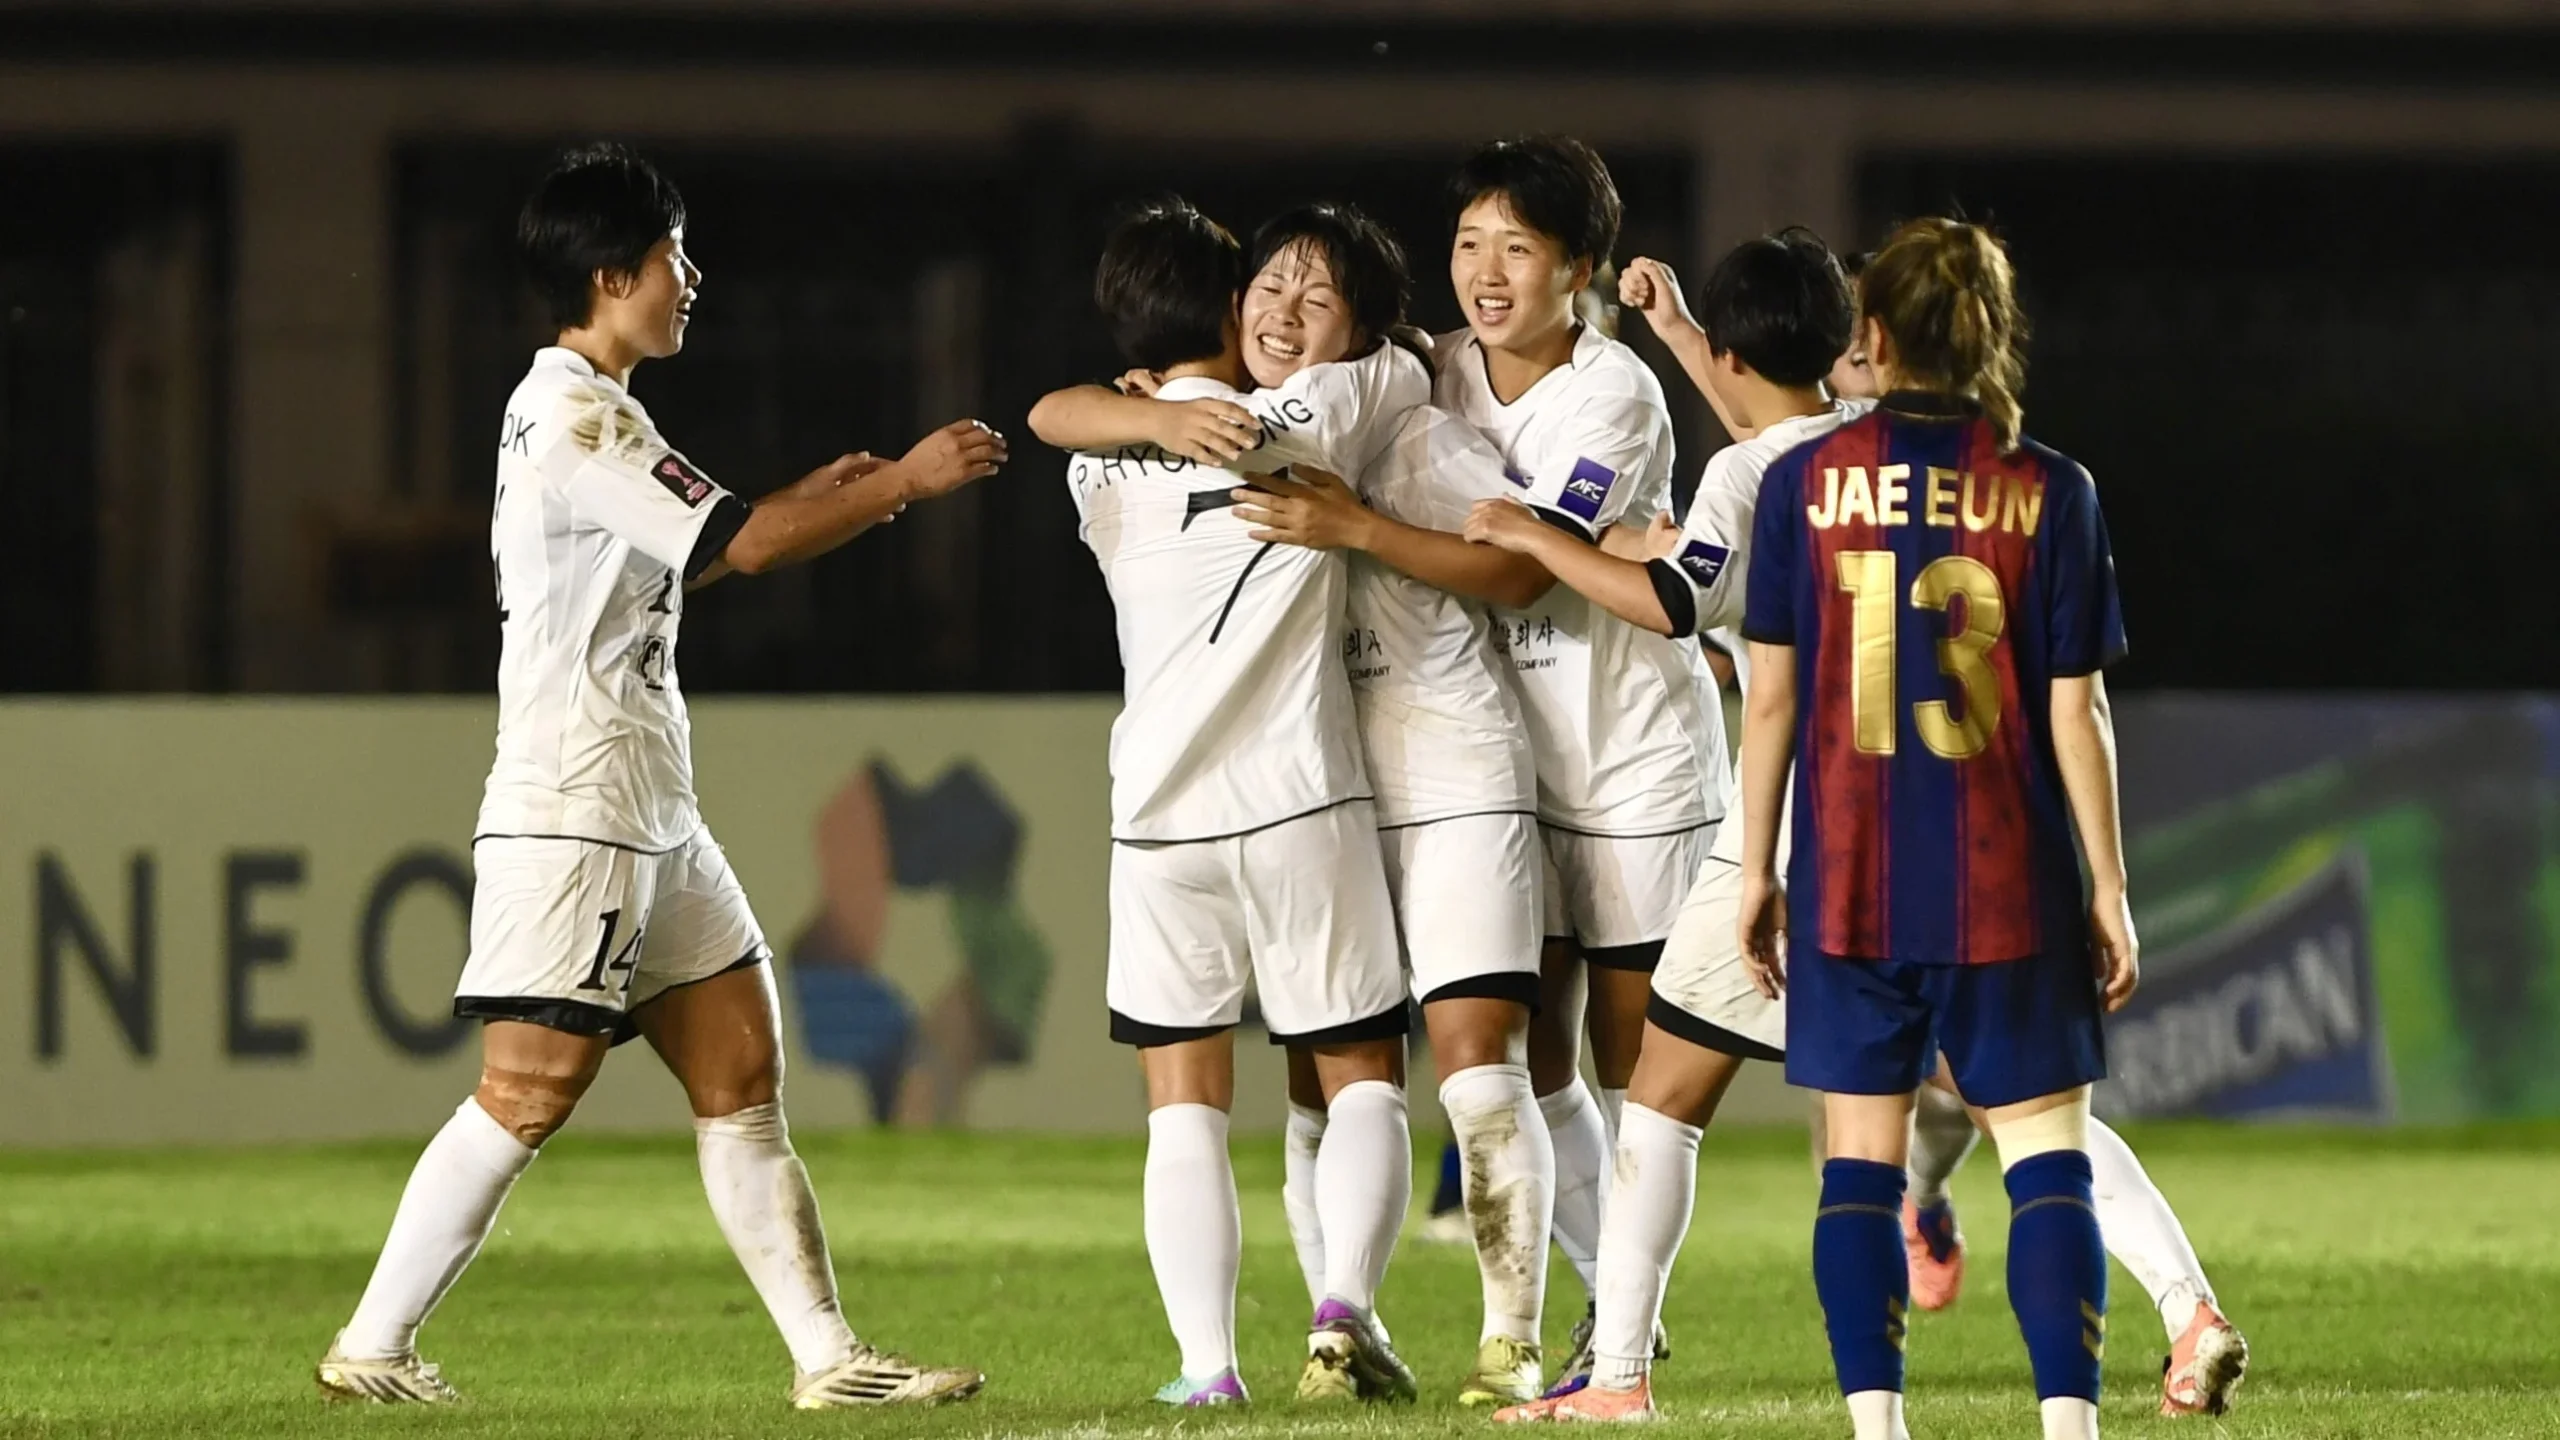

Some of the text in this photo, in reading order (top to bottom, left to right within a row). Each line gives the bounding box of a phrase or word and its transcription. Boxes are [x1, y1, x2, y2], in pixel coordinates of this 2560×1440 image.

[1568, 477, 1605, 501] AFC
[1807, 463, 2044, 537] JAE EUN
[1181, 465, 1289, 645] 7
[1515, 656, 1558, 671] COMPANY
[1834, 551, 2005, 760] 13
